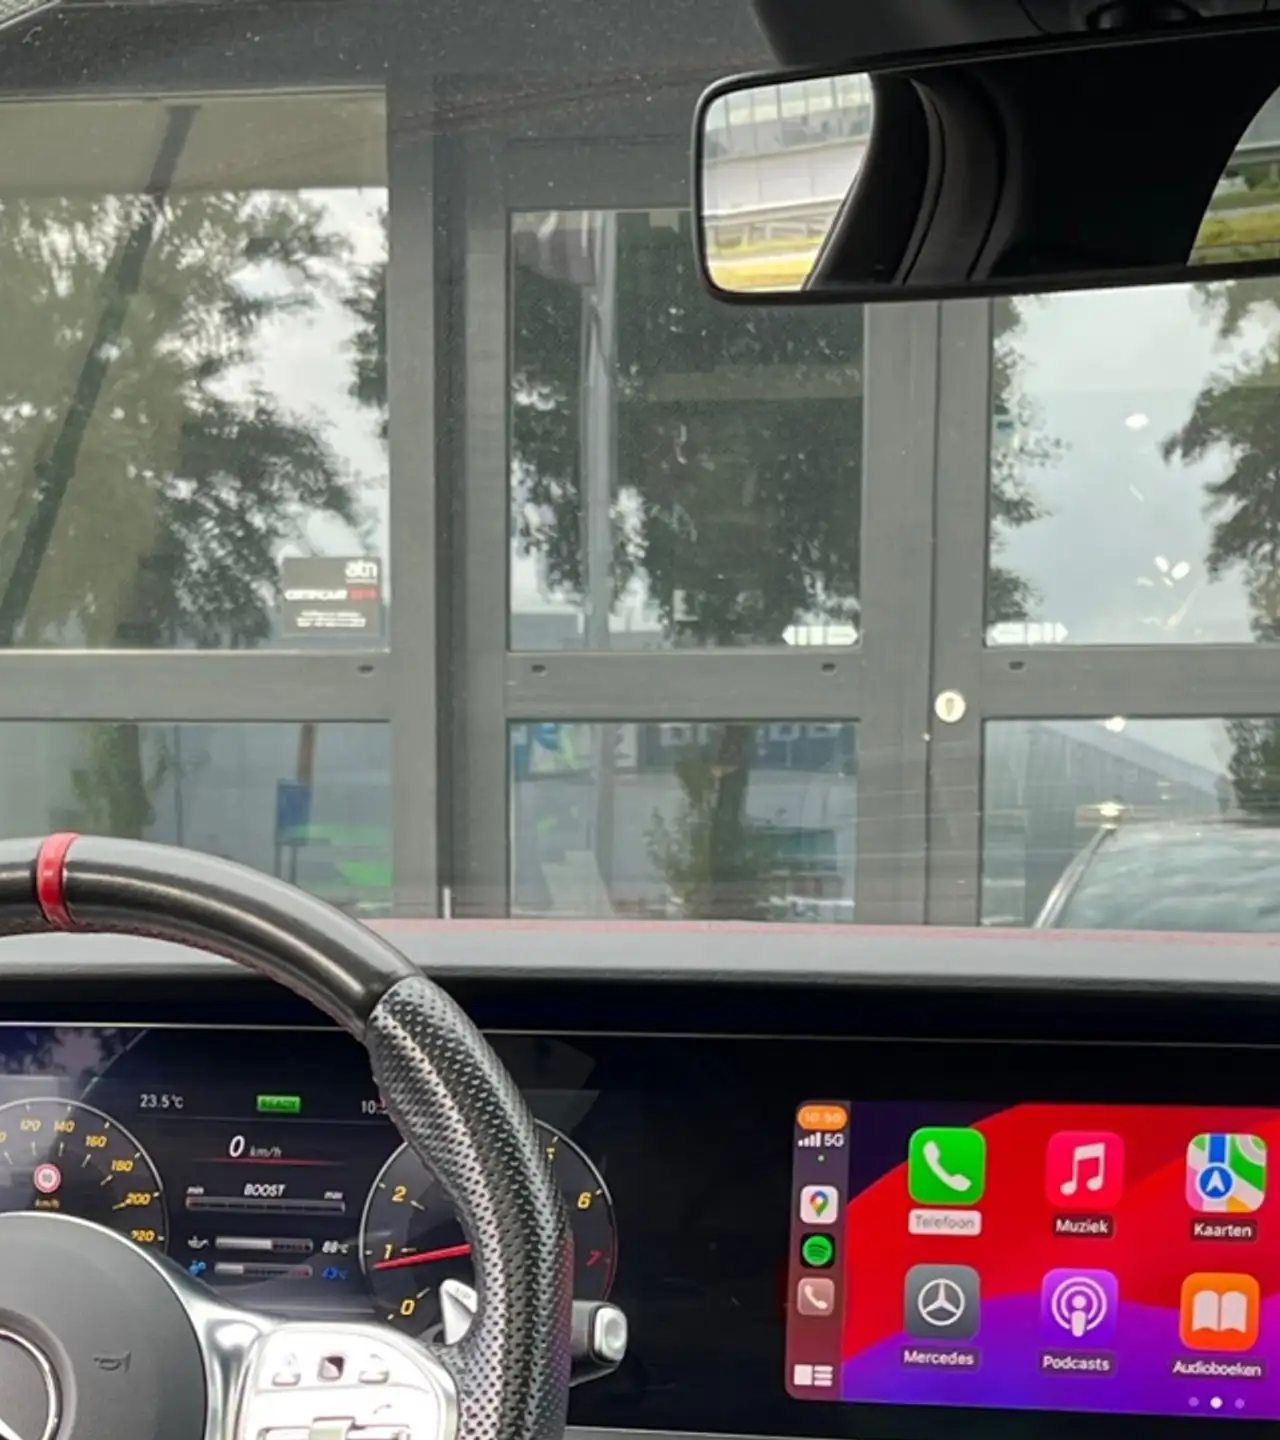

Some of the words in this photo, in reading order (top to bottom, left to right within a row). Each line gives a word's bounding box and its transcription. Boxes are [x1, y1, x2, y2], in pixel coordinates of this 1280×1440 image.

[21, 1119, 41, 1131] 120
[53, 1120, 75, 1133] 140
[228, 1135, 246, 1157] 0
[824, 1133, 844, 1147] 5G
[244, 1183, 286, 1197] BOOST
[391, 1185, 408, 1202] 2
[126, 1193, 151, 1206] 200
[576, 1191, 593, 1209] 6
[914, 1215, 975, 1230] Telefoon
[1056, 1219, 1109, 1234] Muziek
[1193, 1222, 1253, 1239] Kaarten
[400, 1299, 416, 1316] 0
[904, 1349, 975, 1366] Mercedes
[1043, 1355, 1111, 1372] Podcasts
[1172, 1360, 1262, 1378] Audioboeken
